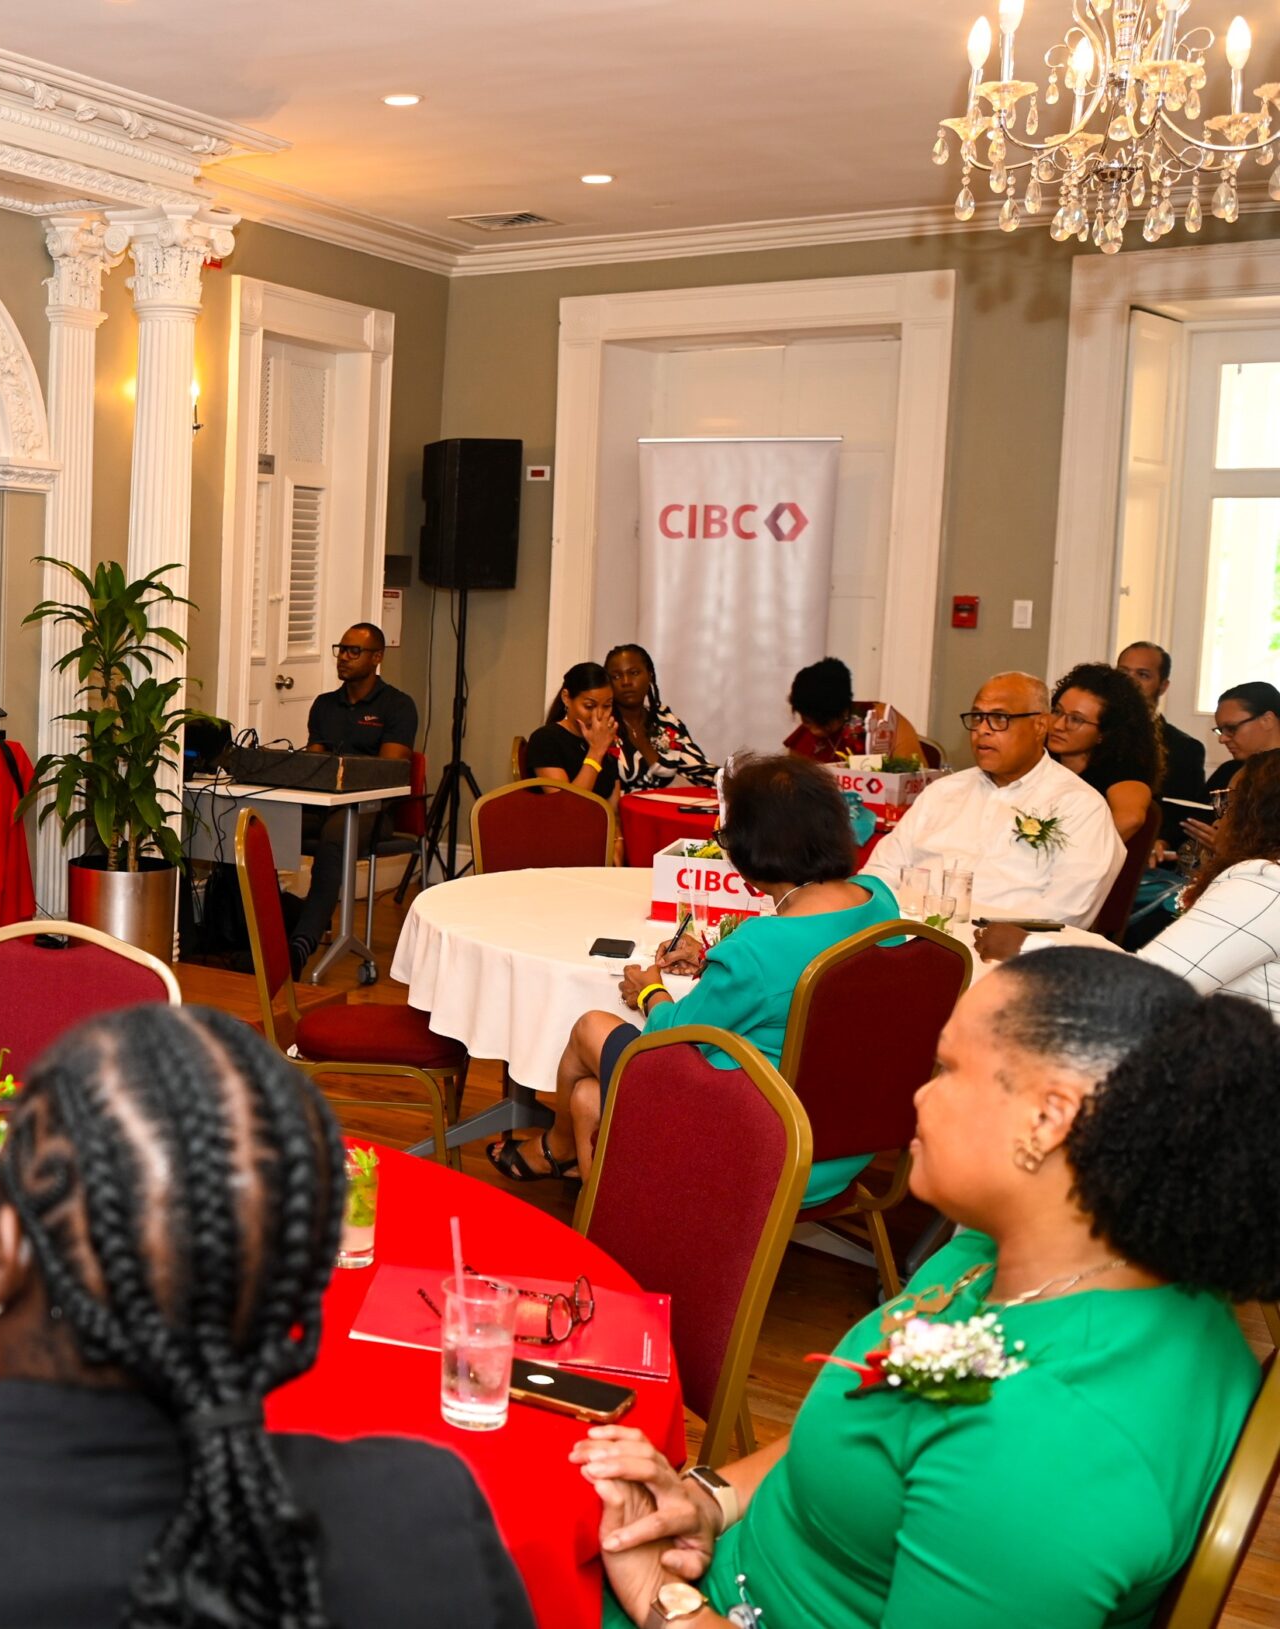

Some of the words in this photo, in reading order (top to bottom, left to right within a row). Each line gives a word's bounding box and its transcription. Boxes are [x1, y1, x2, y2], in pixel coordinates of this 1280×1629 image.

[658, 503, 758, 540] CIBC
[836, 775, 864, 792] IBC
[676, 868, 740, 894] CIBC
